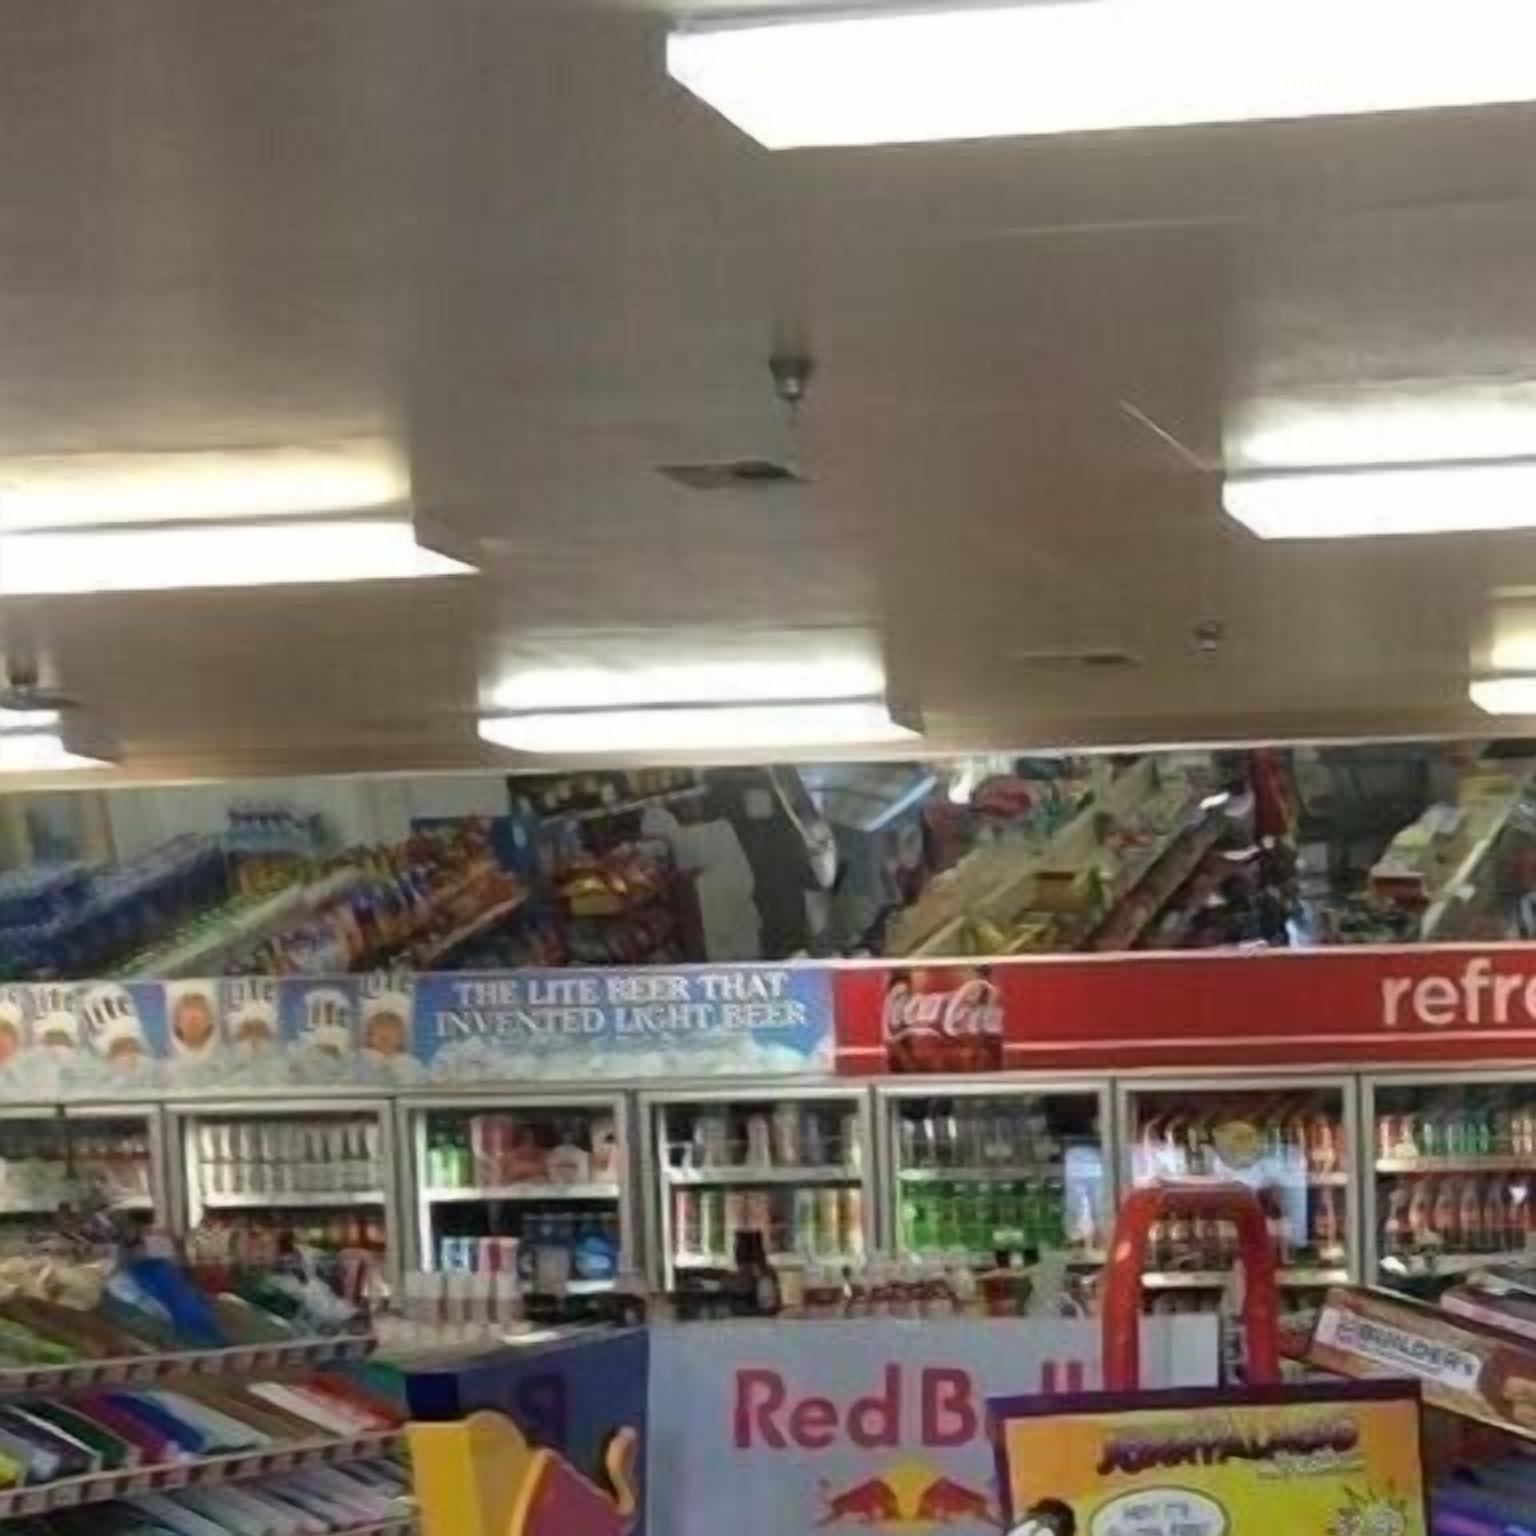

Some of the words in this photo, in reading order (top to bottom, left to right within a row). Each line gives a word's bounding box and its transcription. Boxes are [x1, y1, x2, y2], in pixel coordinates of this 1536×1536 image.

[452, 981, 517, 1005] THE
[528, 978, 598, 1004] LITE
[608, 975, 691, 1002] BEER
[700, 971, 789, 999] THAT
[436, 1007, 605, 1036] INVENTED
[614, 1004, 715, 1034] LIGHT
[723, 1000, 806, 1028] BEER
[733, 1362, 900, 1448] Red
